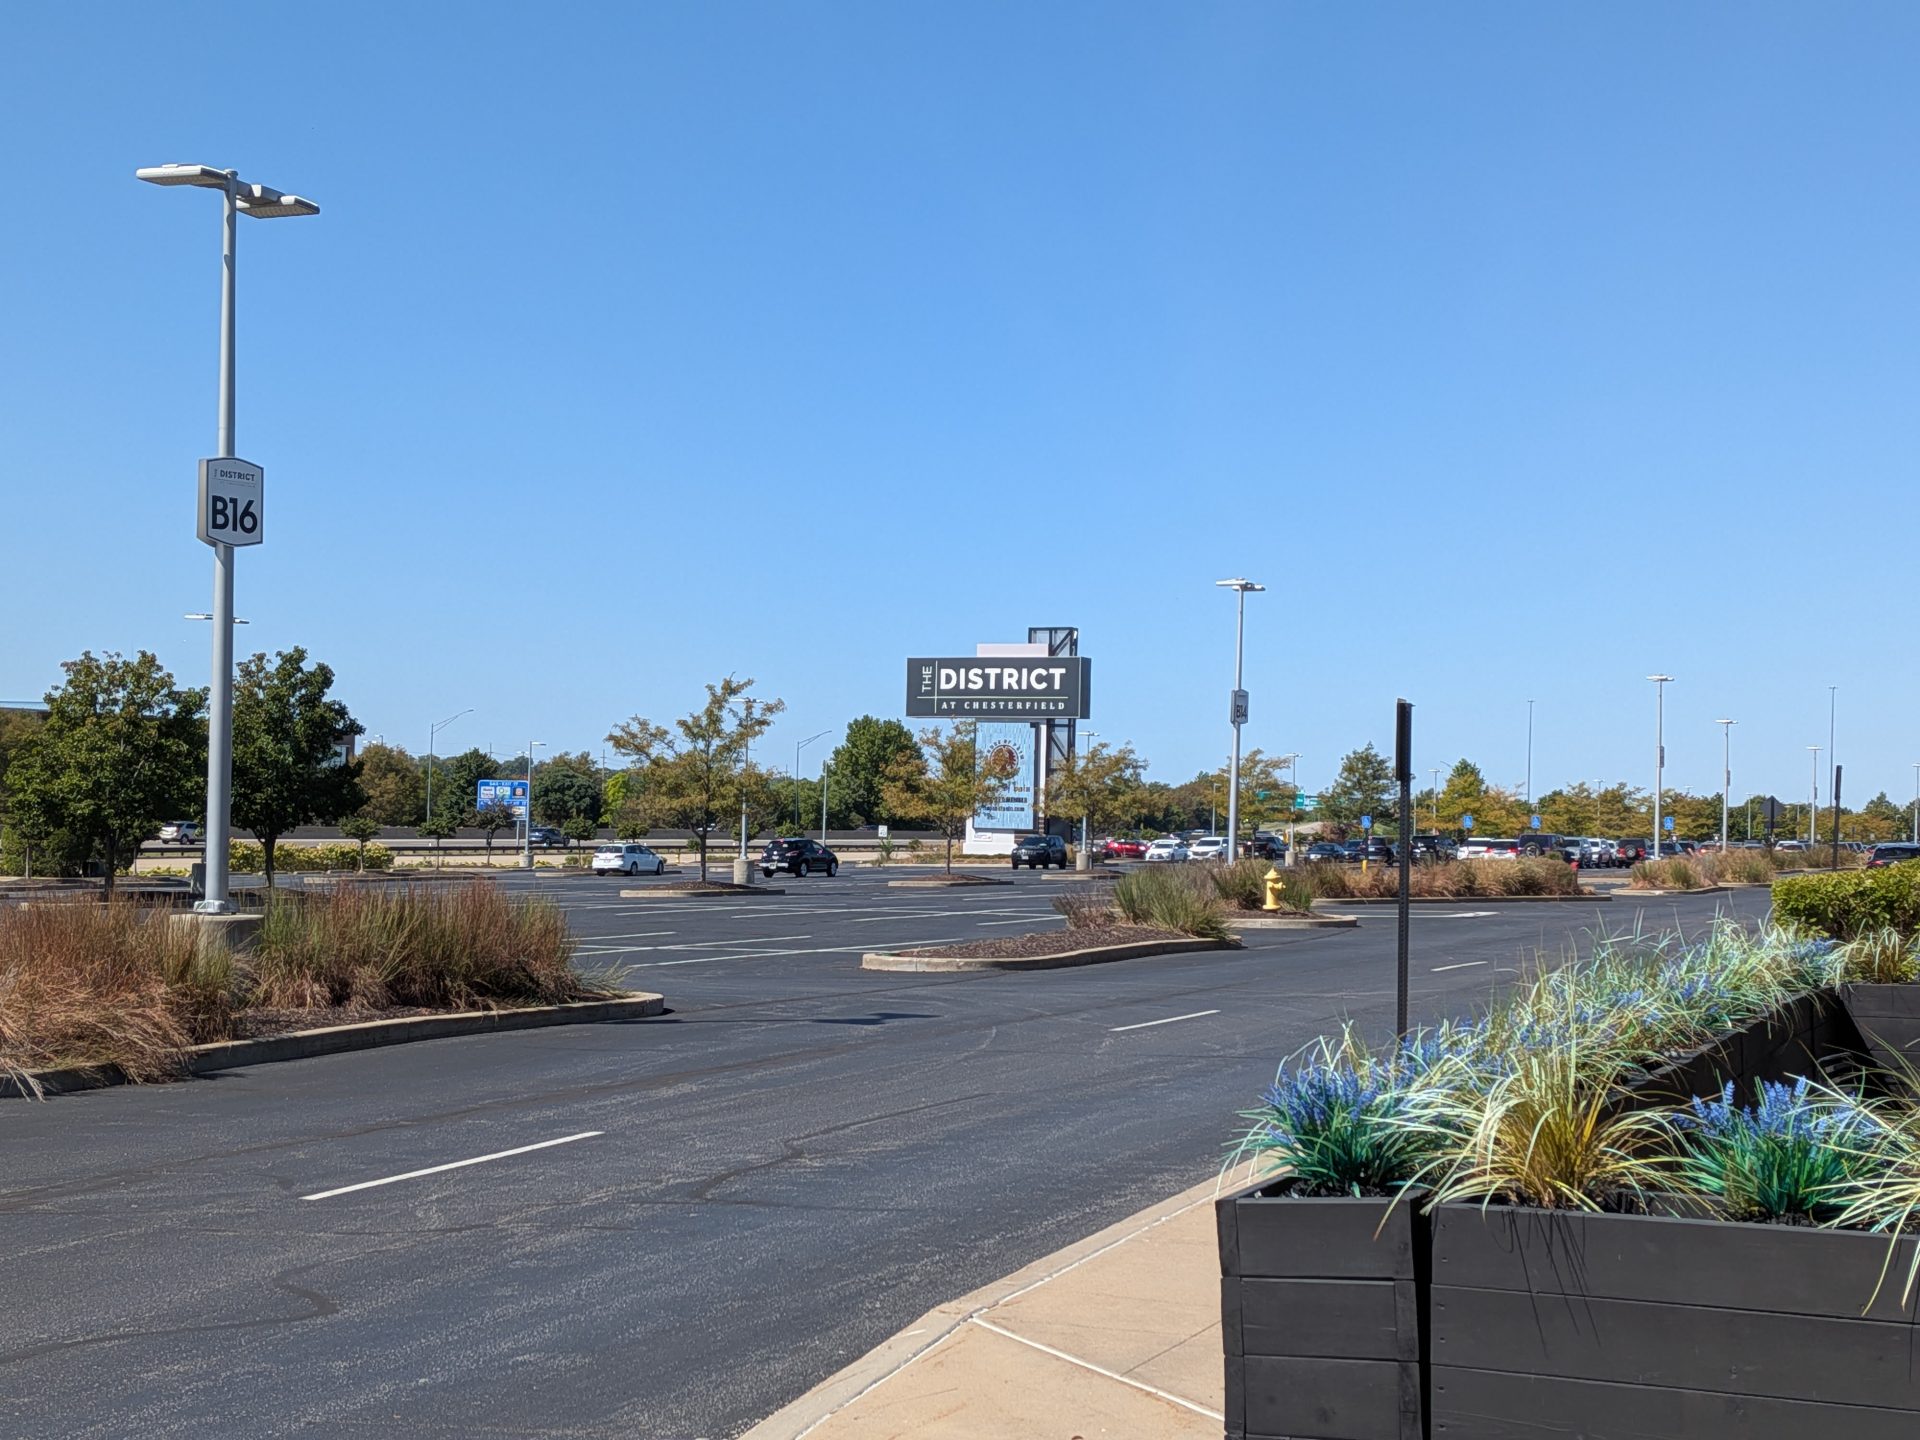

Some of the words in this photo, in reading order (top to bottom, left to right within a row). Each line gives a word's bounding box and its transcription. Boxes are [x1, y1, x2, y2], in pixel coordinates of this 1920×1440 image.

[220, 470, 256, 481] DISTRICT
[212, 495, 258, 534] B16
[922, 666, 932, 692] THE
[940, 668, 1066, 690] DISTRICT
[942, 702, 956, 710] AT
[964, 702, 1065, 710] CHESTERFIELD
